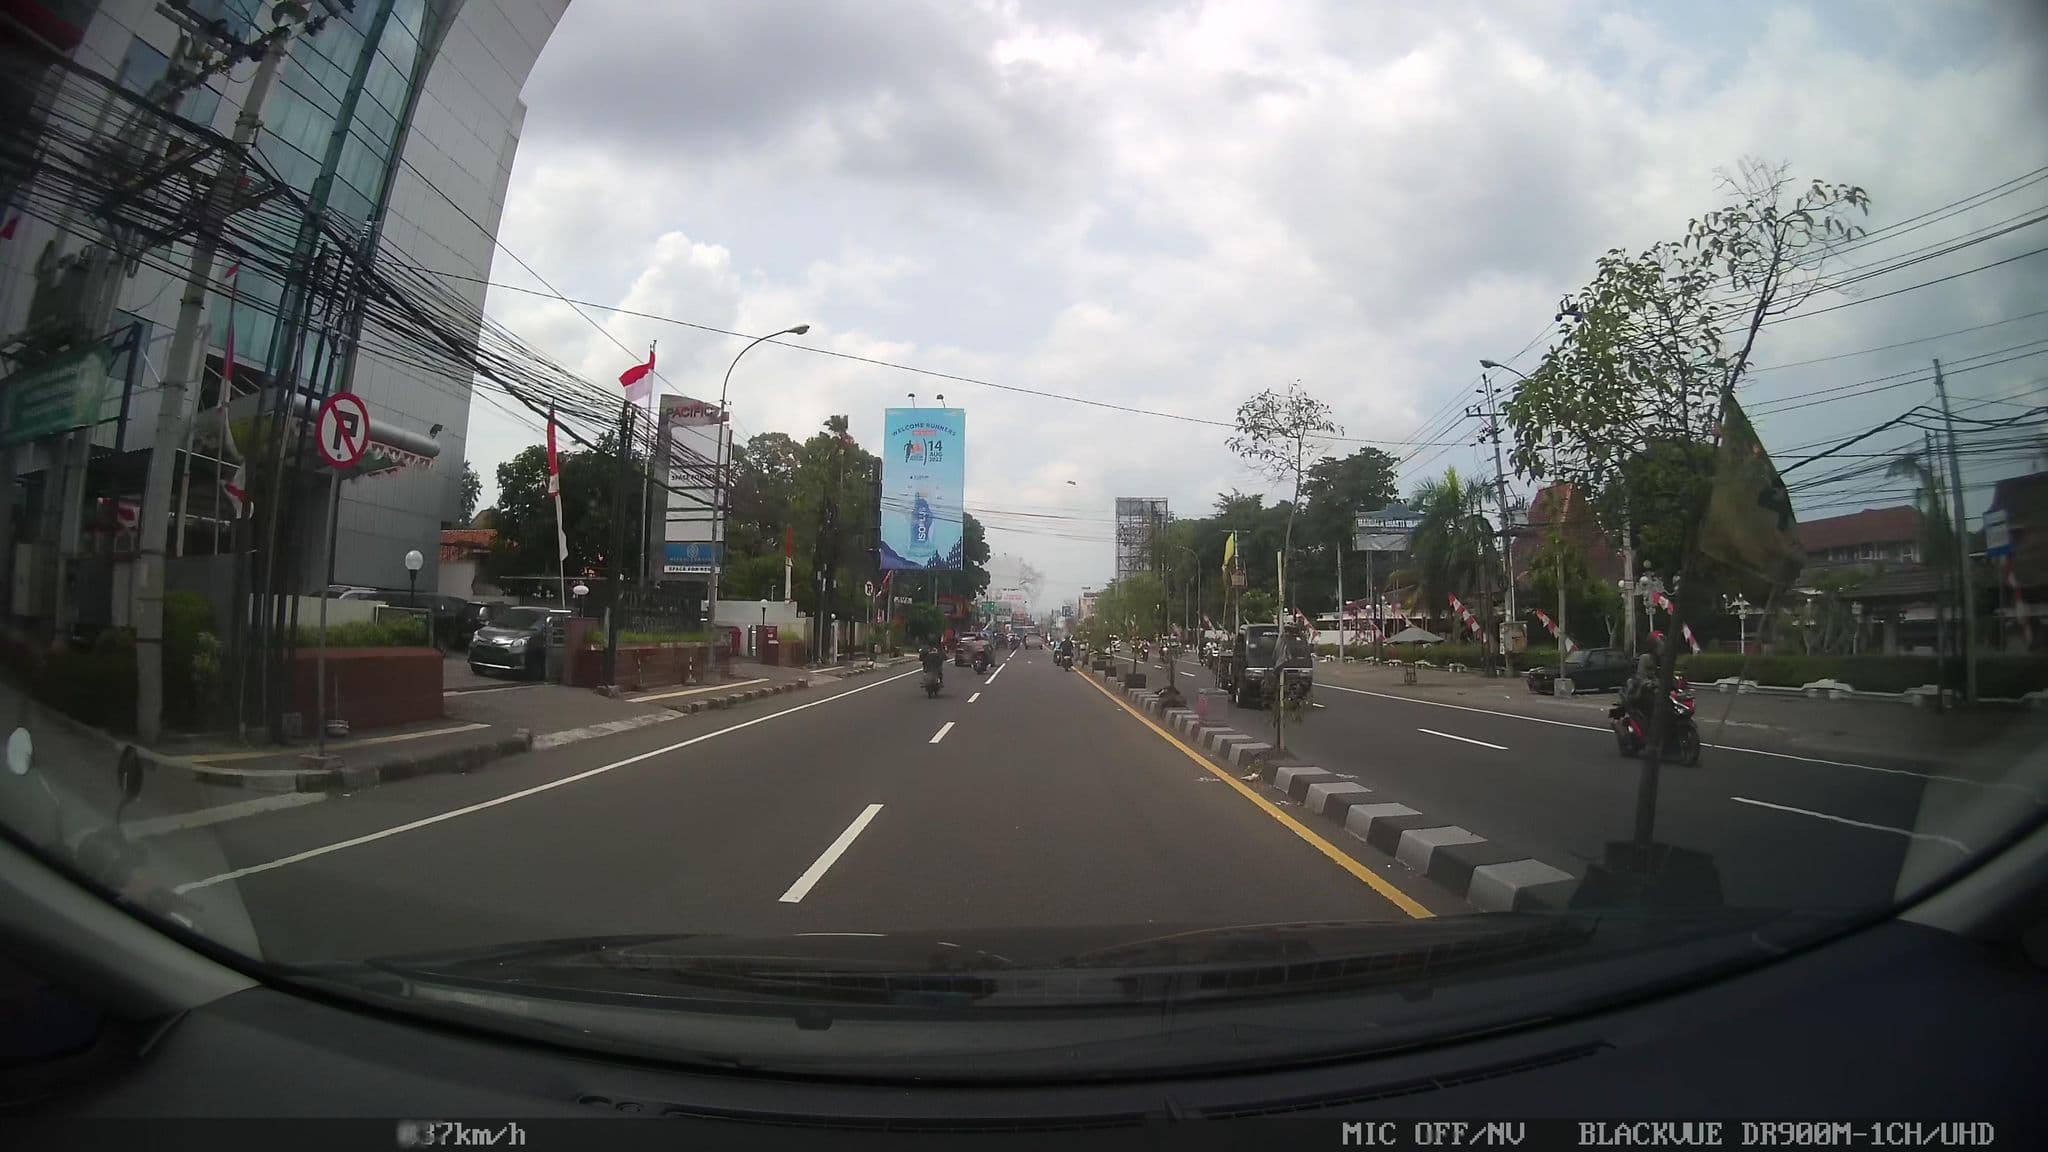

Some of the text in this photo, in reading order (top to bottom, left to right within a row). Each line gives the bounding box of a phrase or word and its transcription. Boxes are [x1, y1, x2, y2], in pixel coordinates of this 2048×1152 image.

[666, 404, 714, 418] PACIFIC
[333, 410, 359, 451] P
[892, 423, 925, 437] WELCOME
[925, 423, 957, 437] RUNNERS
[928, 440, 943, 452] 14
